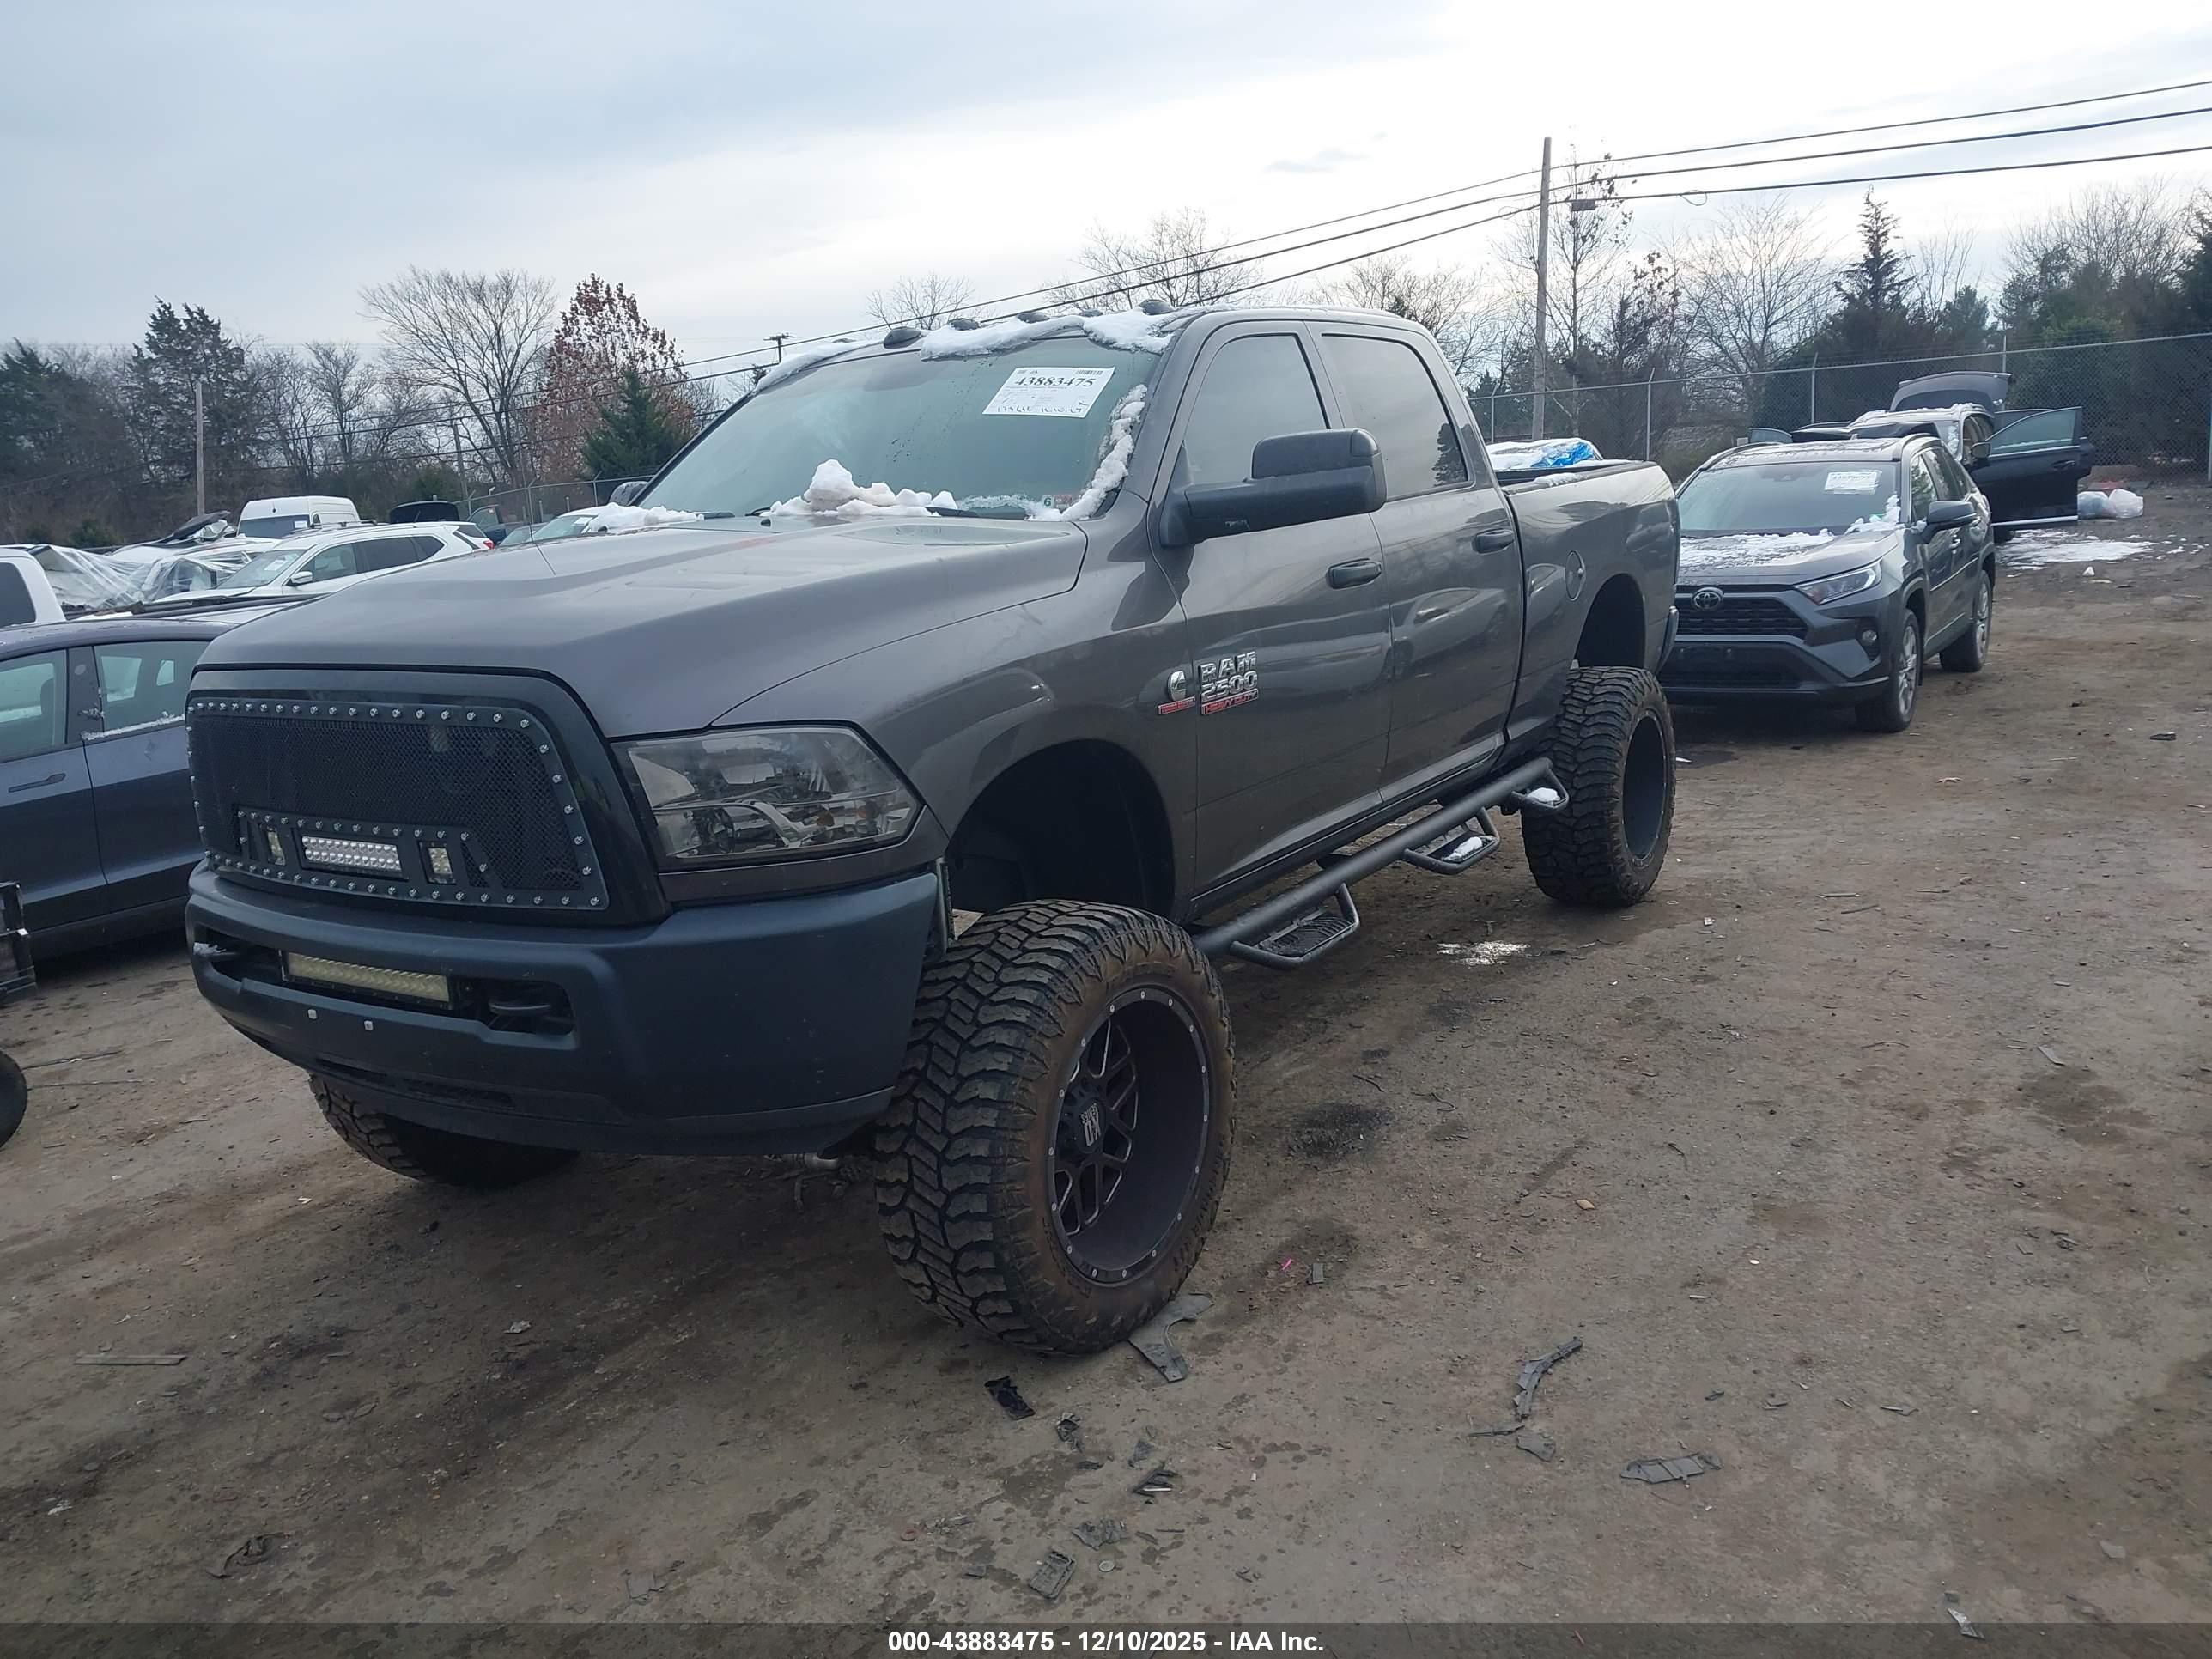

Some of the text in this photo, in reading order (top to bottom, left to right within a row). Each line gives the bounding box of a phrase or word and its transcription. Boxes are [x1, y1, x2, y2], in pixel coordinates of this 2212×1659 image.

[1015, 376, 1096, 387] 43883475
[1043, 497, 1052, 507] 6
[1200, 651, 1256, 683] RAM
[1201, 671, 1258, 702] 2500
[1234, 690, 1257, 704] DUTY
